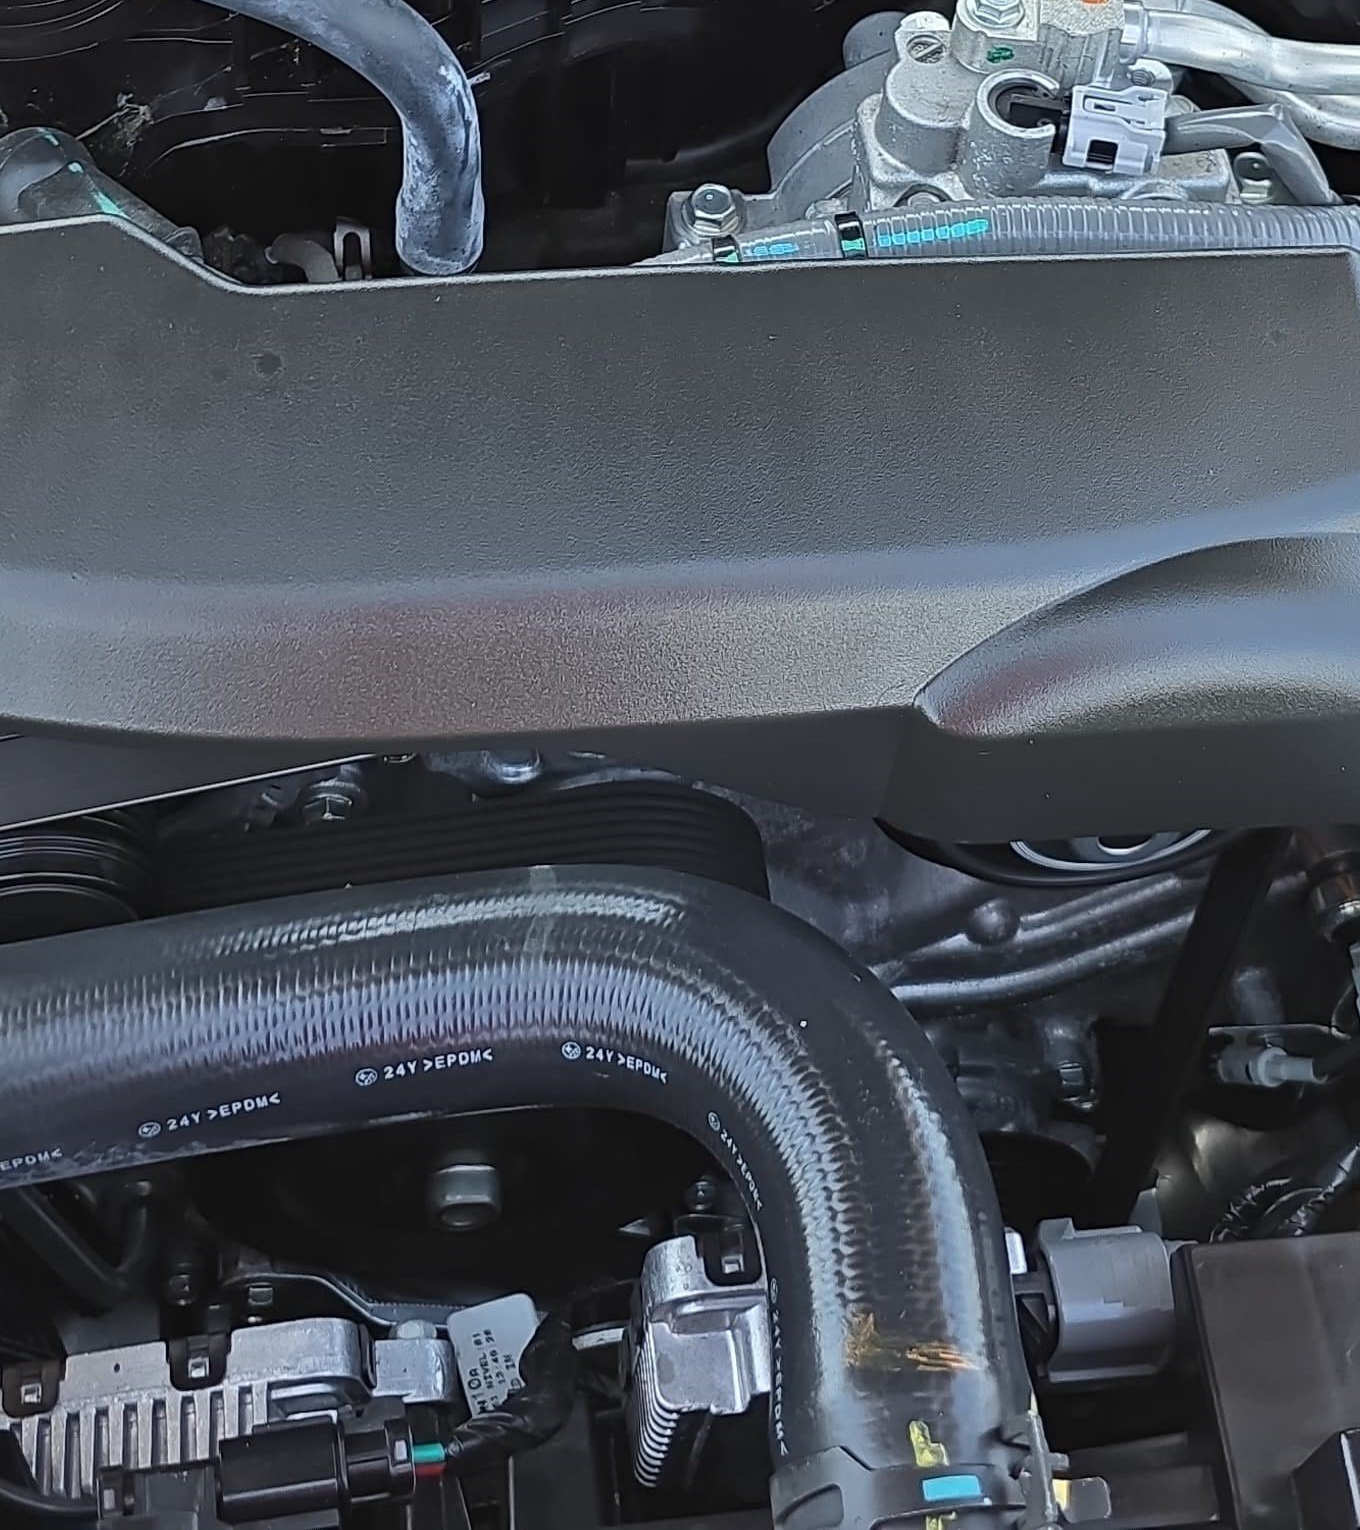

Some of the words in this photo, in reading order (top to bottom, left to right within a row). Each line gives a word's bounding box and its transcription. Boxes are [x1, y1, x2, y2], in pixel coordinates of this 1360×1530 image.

[383, 1058, 418, 1081] 24Y
[422, 1047, 494, 1072] >EPDM<
[585, 1045, 614, 1063] 24Y
[616, 1051, 669, 1085] >EPDM<
[166, 1110, 202, 1131] 24Y
[206, 1091, 282, 1120] >EPDM<
[719, 1128, 738, 1155] 24Y
